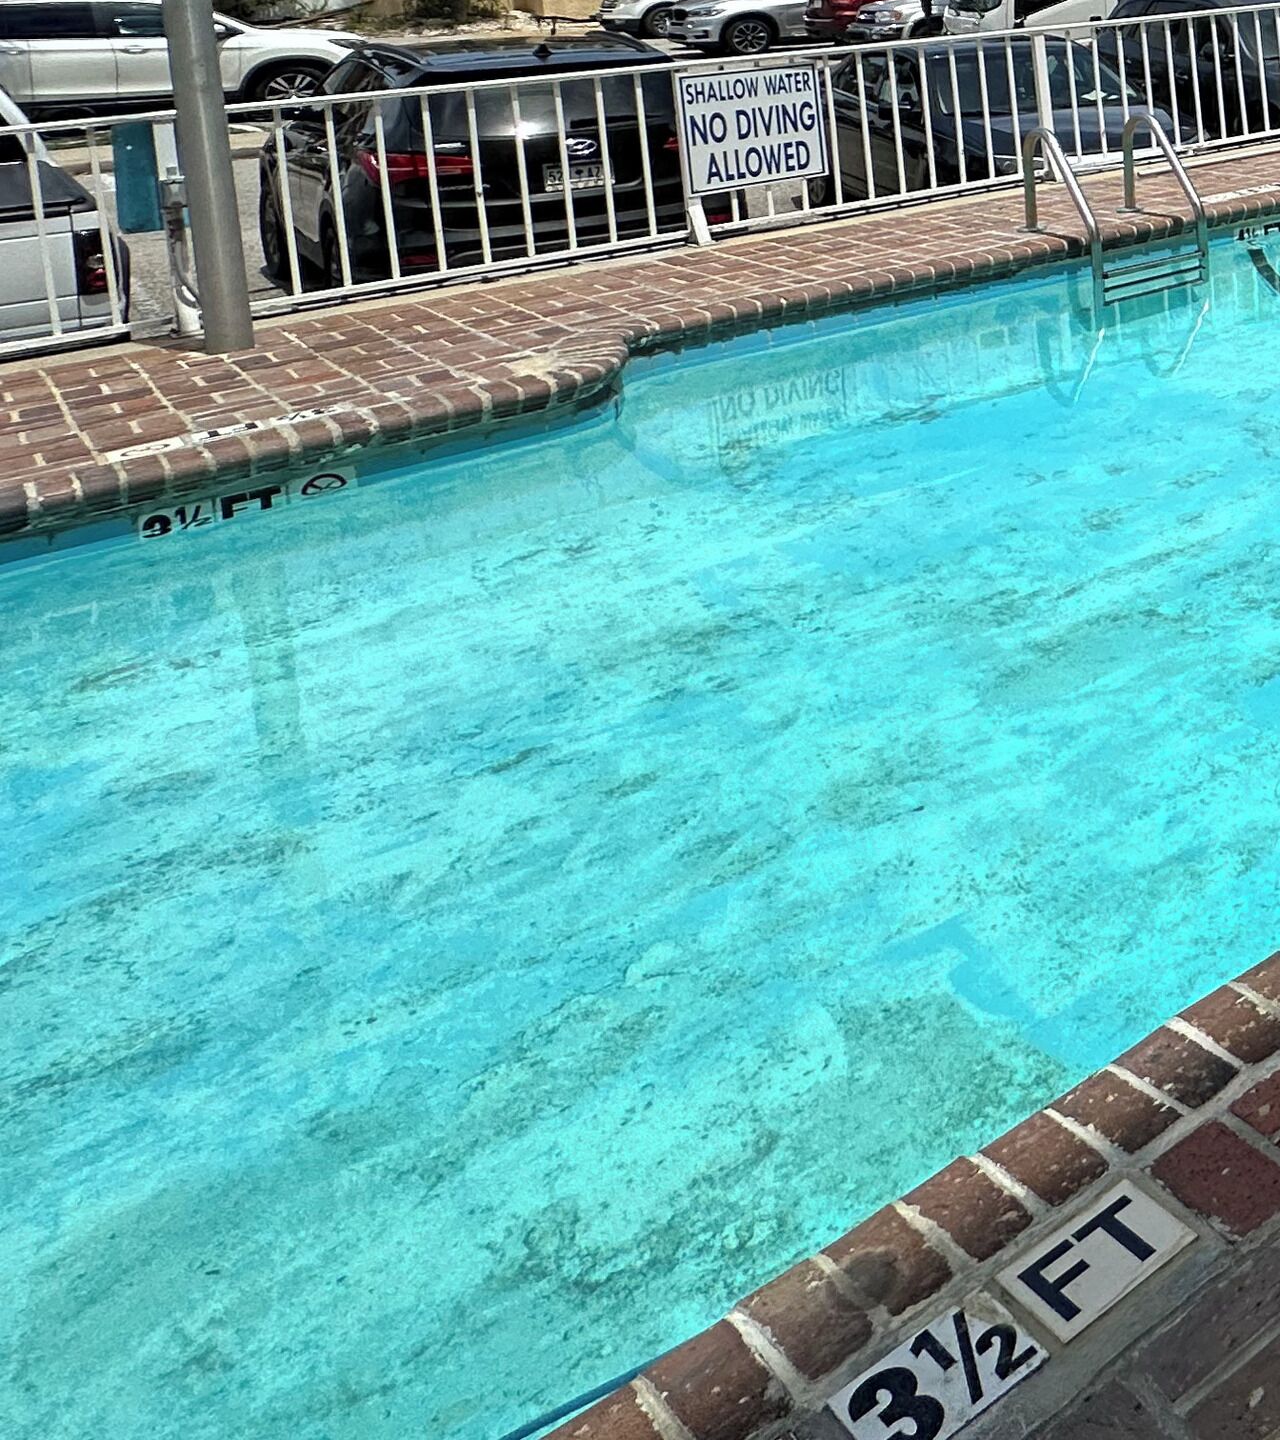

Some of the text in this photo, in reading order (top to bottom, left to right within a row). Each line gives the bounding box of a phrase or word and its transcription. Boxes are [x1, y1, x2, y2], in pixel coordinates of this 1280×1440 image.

[685, 71, 811, 105] SHALLOW WATER
[690, 101, 815, 146] NO DIVING
[707, 140, 809, 184] ALLOWED
[221, 485, 281, 520] FT
[1017, 1195, 1157, 1322] FT
